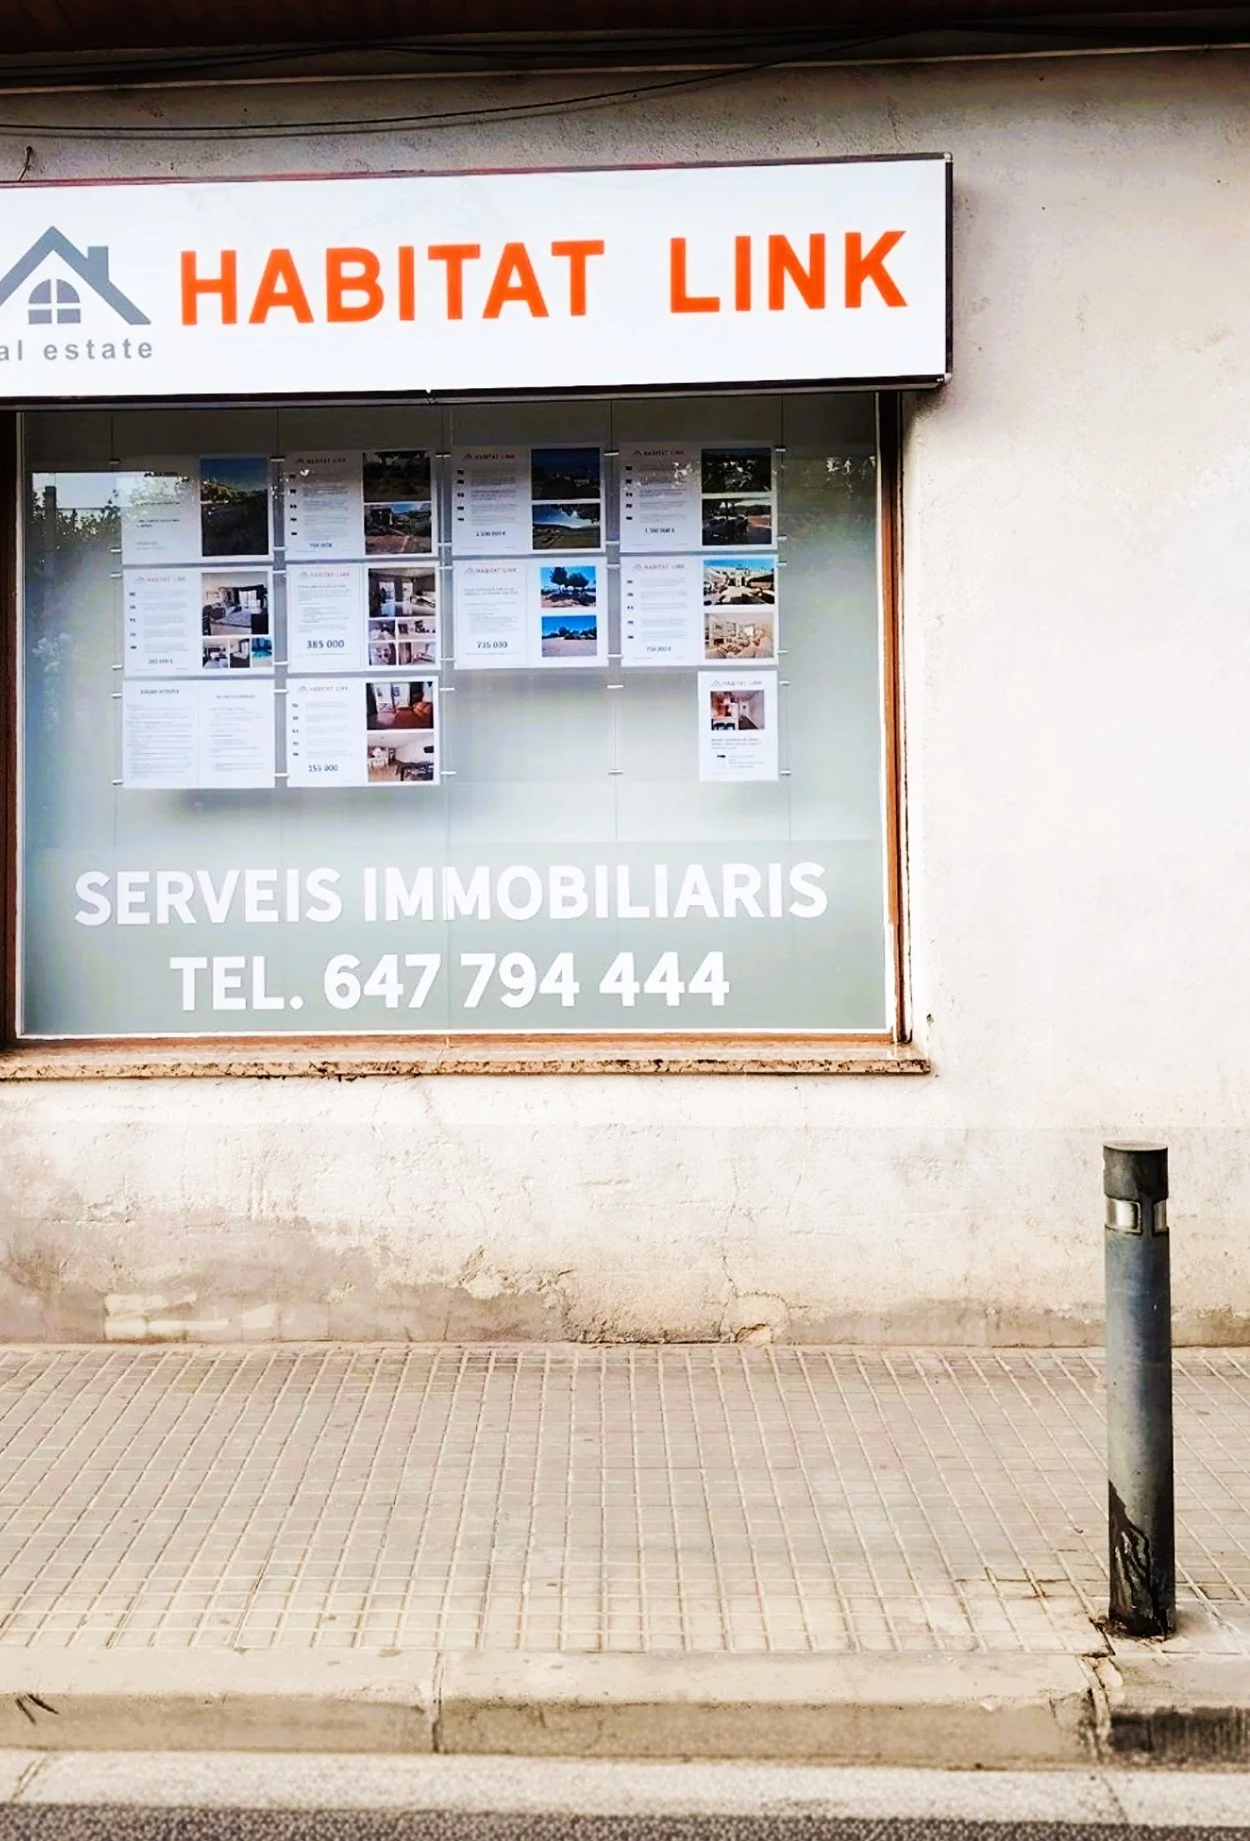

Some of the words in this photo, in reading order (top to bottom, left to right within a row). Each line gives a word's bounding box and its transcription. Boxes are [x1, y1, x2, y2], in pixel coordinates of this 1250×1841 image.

[180, 239, 605, 326] HABITAT
[668, 230, 907, 314] LINK
[43, 337, 154, 361] estate
[306, 639, 324, 649] 385
[326, 639, 345, 648] 000
[75, 867, 342, 926] SERVEIS
[362, 862, 828, 921] IMMOBILIARIS
[170, 956, 304, 1011] TEL.
[324, 954, 441, 1010] 647
[460, 952, 580, 1008] 794
[599, 951, 730, 1007] 444
